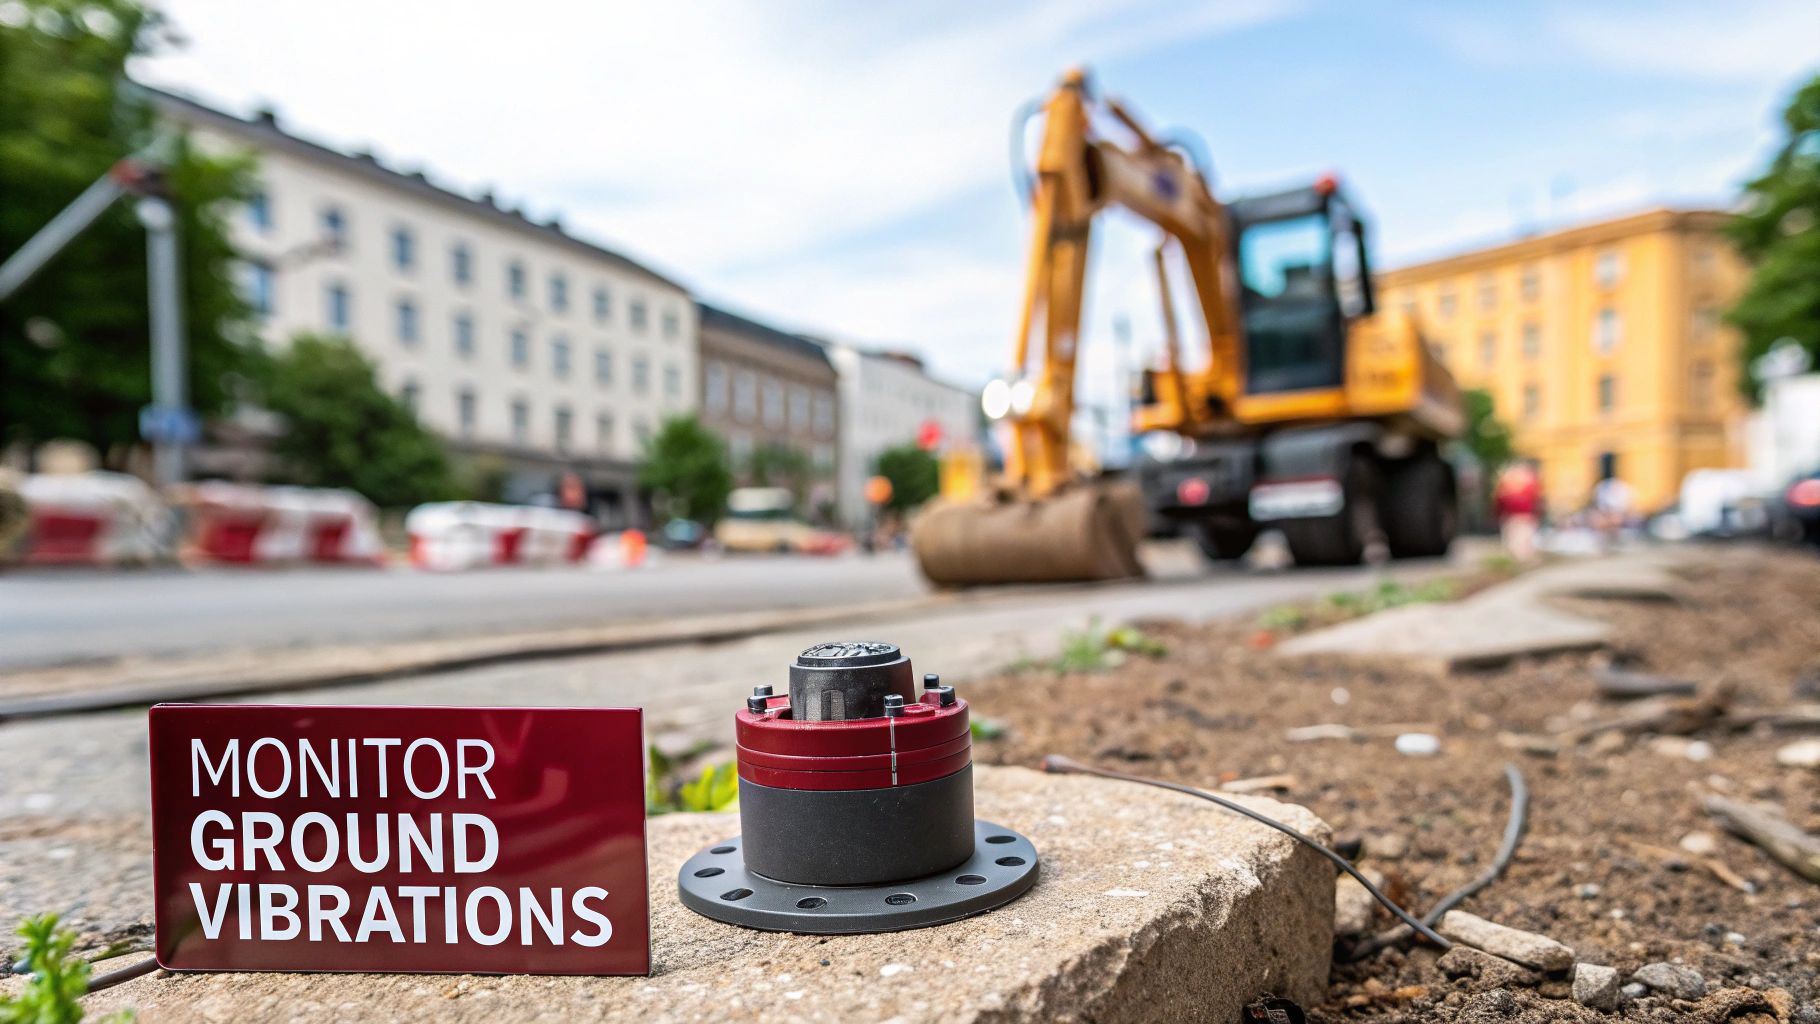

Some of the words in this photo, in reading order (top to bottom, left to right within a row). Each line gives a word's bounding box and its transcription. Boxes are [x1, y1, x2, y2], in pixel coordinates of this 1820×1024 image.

[192, 738, 496, 799] MONITOR
[191, 810, 498, 873] GROUND
[189, 883, 612, 947] VIBRATIONS
